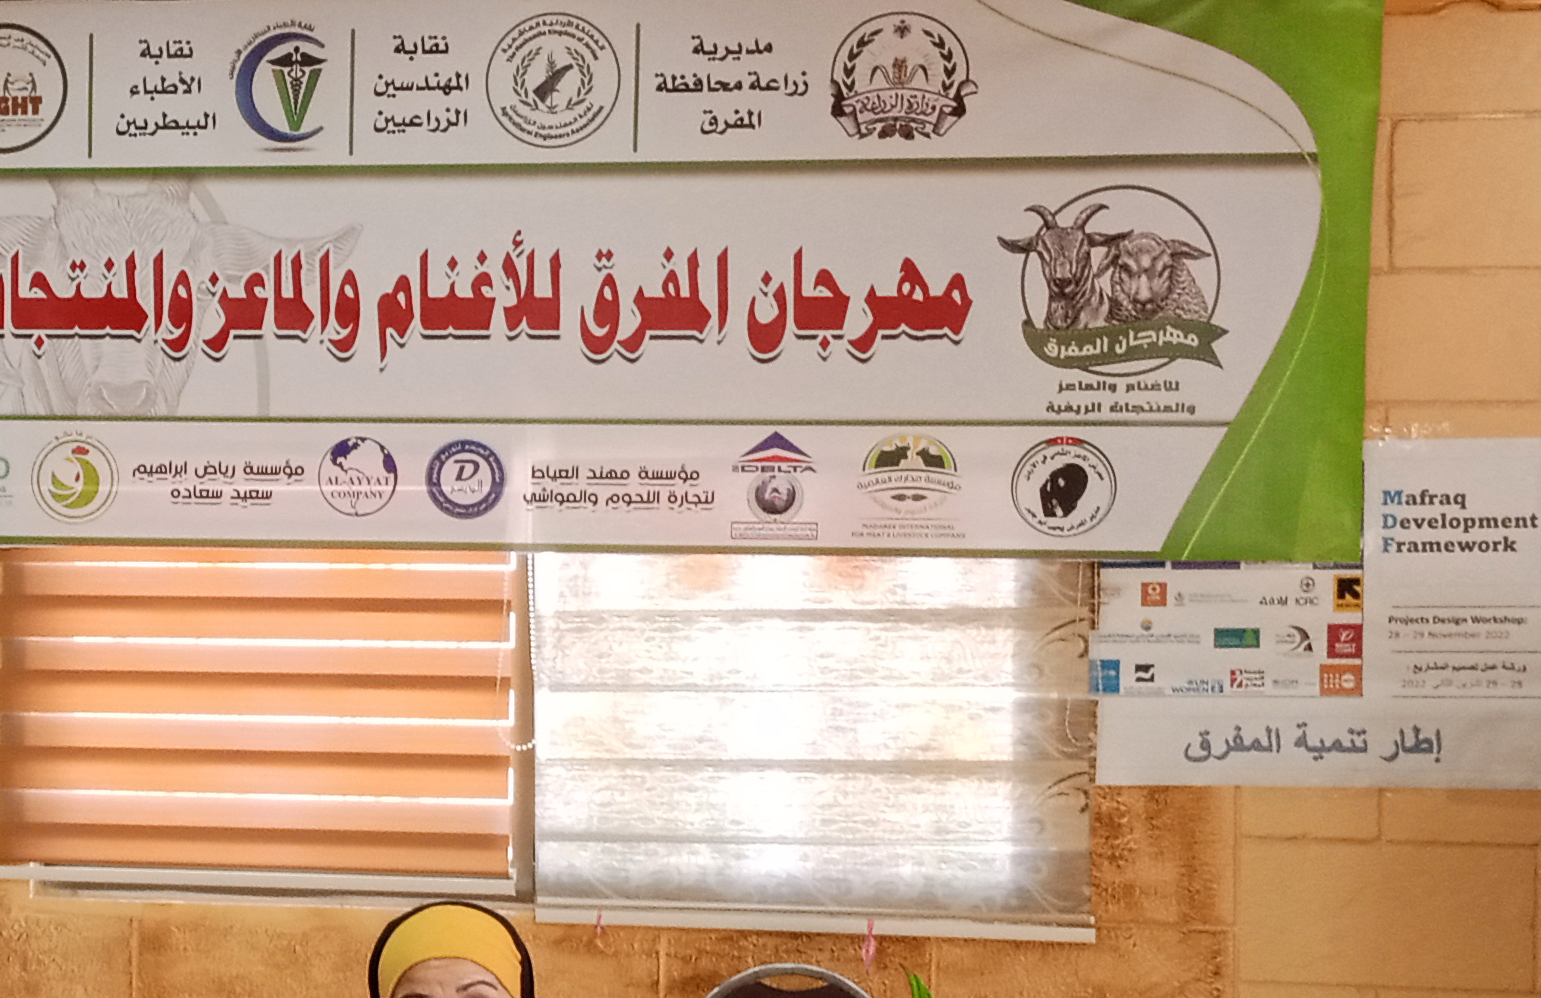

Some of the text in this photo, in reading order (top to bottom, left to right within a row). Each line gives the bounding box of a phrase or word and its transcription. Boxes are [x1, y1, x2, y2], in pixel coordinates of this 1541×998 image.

[138, 39, 194, 65] نقابة
[392, 34, 449, 61] نقابة
[691, 35, 773, 61] مديرية
[129, 70, 201, 101] الأطباء
[373, 70, 469, 98] المهندسين
[654, 70, 809, 96] زراعة محافظة
[115, 111, 217, 138] البيطريين
[373, 107, 468, 134] الزراعيين
[700, 108, 762, 135] المفرق
[201, 244, 361, 358] والماعز
[377, 229, 562, 370] للأغنام
[579, 245, 730, 358] المفرق
[747, 245, 974, 360] مهرجان
[1043, 324, 1199, 360] مهرجان المفرق
[1045, 401, 1101, 415] الريفية
[132, 459, 305, 480] مؤسسة رياض ابراهيم
[325, 476, 391, 486] AL-AYYAT
[531, 464, 700, 484] مؤسسة مهند العياط
[170, 485, 273, 502] سعيد سعاده
[330, 490, 385, 500] COMPANY
[523, 487, 715, 508] لتجارة اللحوم والمواشي
[1382, 489, 1467, 509] Mafraq
[1382, 512, 1539, 533] Development
[1382, 536, 1518, 553] Framework
[1388, 615, 1429, 625] Projects
[1432, 615, 1468, 626] Design
[1427, 630, 1481, 639] November
[1184, 721, 1442, 764] إطار تنمية المفرق
